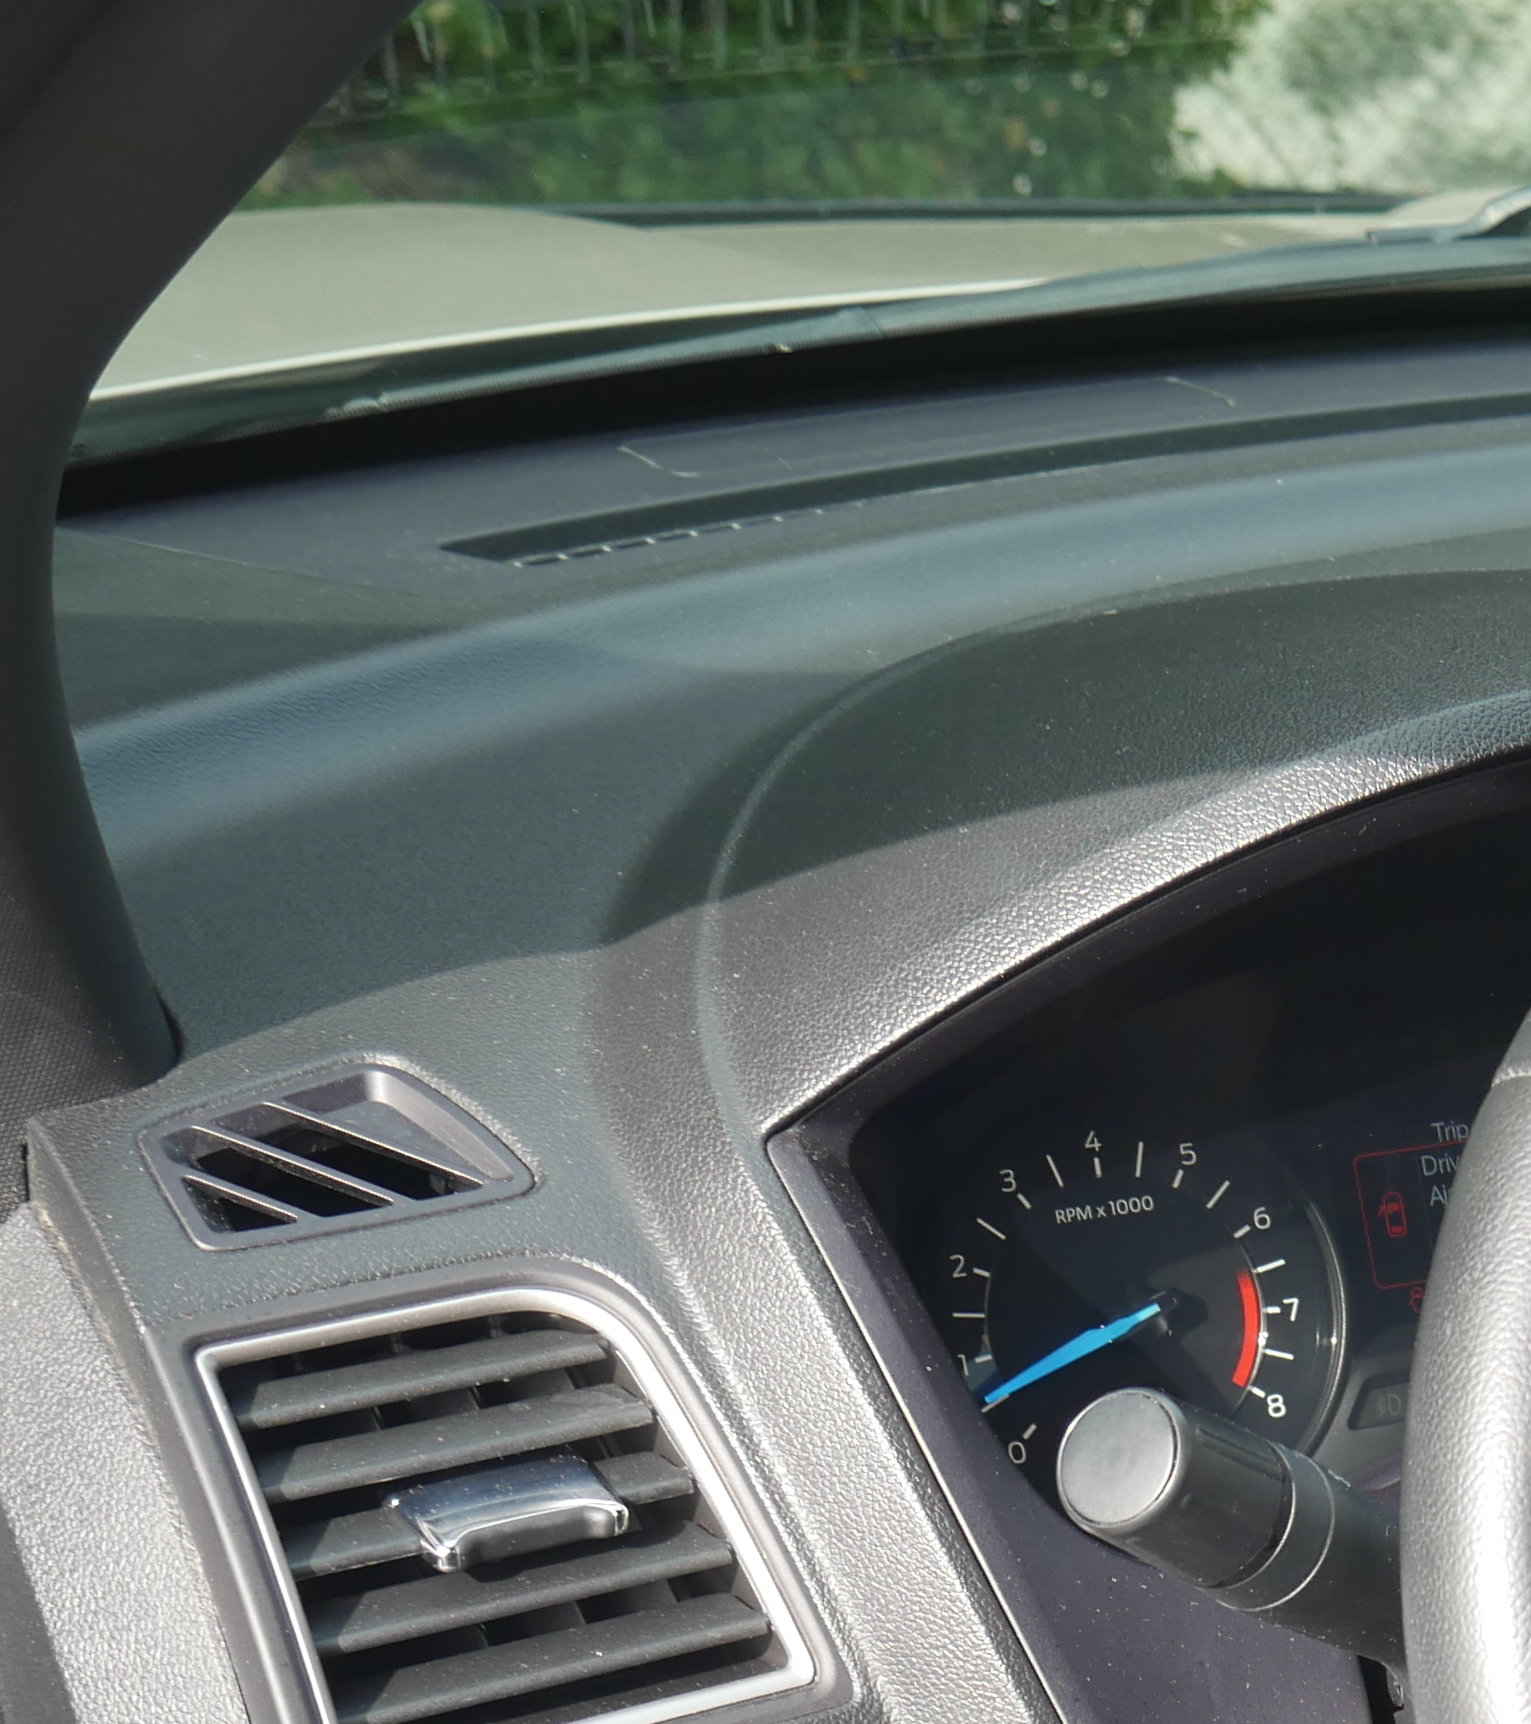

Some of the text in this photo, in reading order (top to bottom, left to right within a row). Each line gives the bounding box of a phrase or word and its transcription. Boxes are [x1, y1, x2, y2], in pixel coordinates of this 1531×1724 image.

[1084, 1130, 1102, 1151] 4
[1430, 1121, 1469, 1143] Trip
[1180, 1143, 1197, 1165] 5
[1000, 1170, 1017, 1192] 3
[1055, 1205, 1092, 1224] RPM
[1254, 1208, 1272, 1230] 6
[950, 1255, 967, 1278] 2
[1283, 1298, 1299, 1322] 7
[957, 1355, 970, 1377] 1
[1267, 1395, 1286, 1418] 8
[1008, 1442, 1026, 1465] 0
